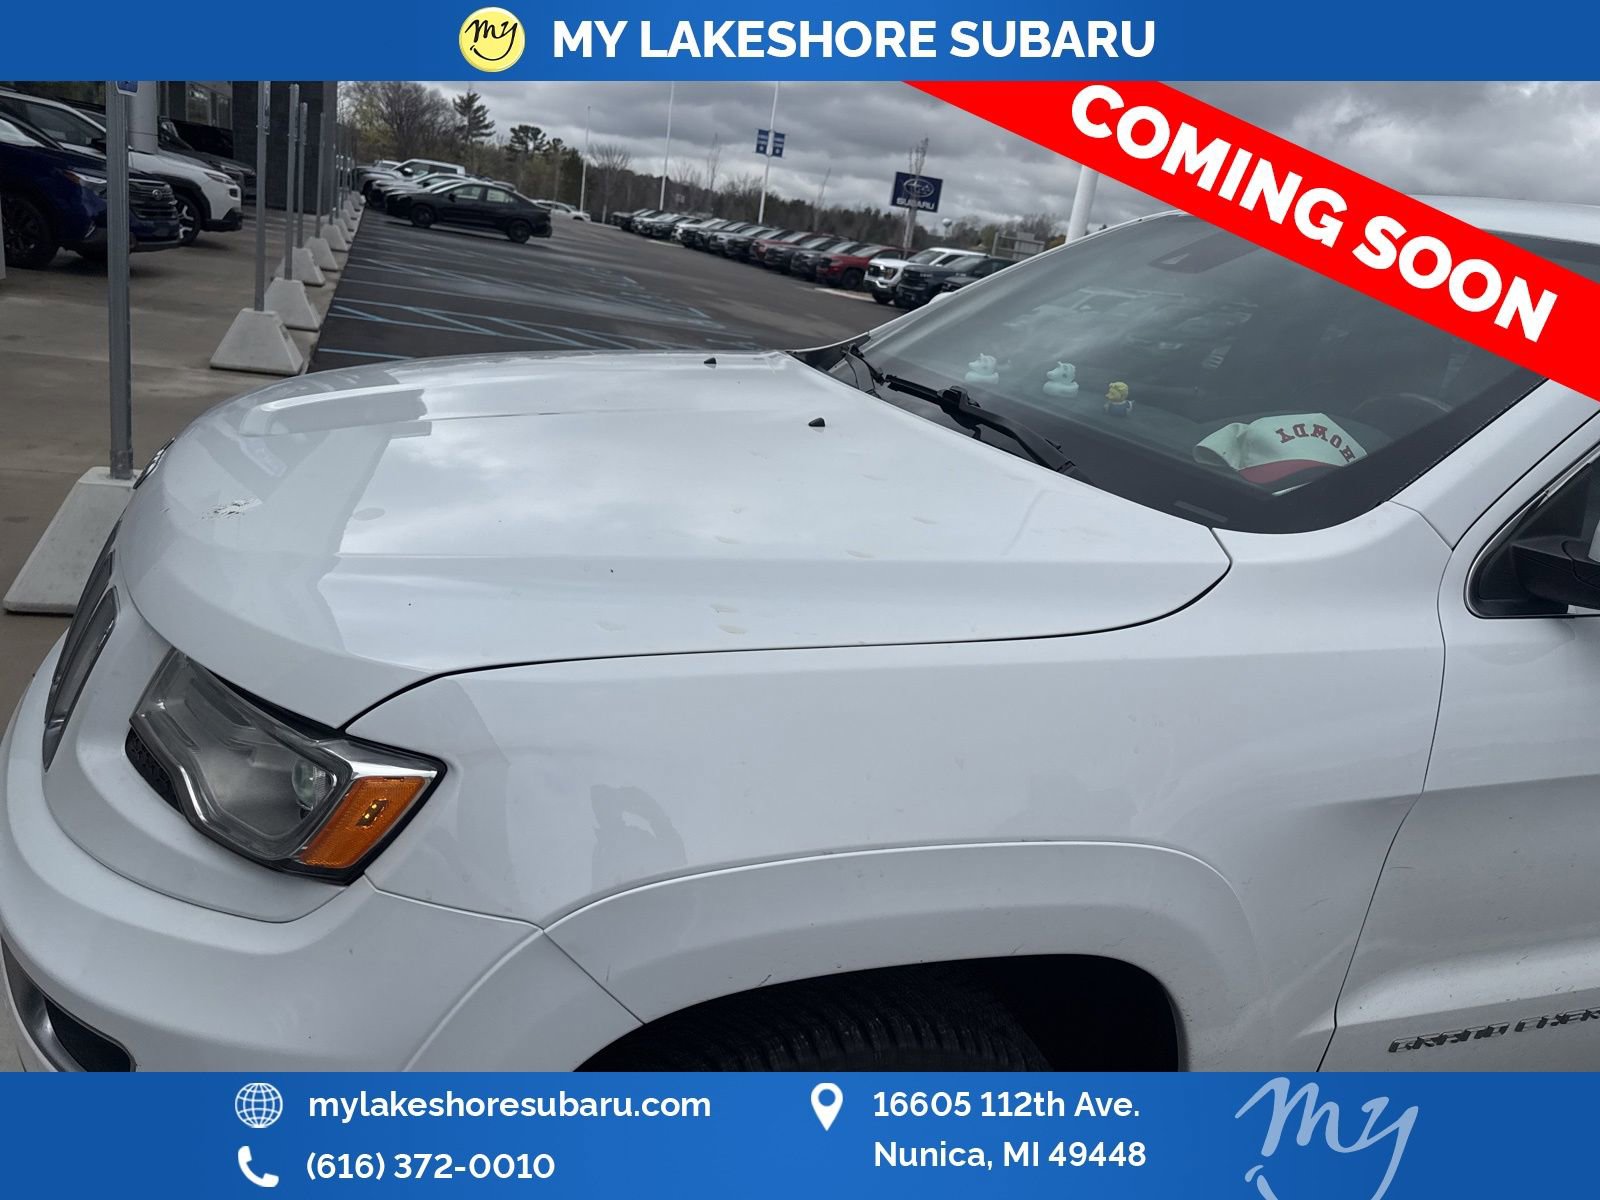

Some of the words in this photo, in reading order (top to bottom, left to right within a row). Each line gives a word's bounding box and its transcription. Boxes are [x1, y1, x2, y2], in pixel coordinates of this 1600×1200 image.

[896, 197, 936, 211] SUBARU
[1275, 423, 1356, 463] HOWDY
[1388, 1021, 1511, 1053] GRAND
